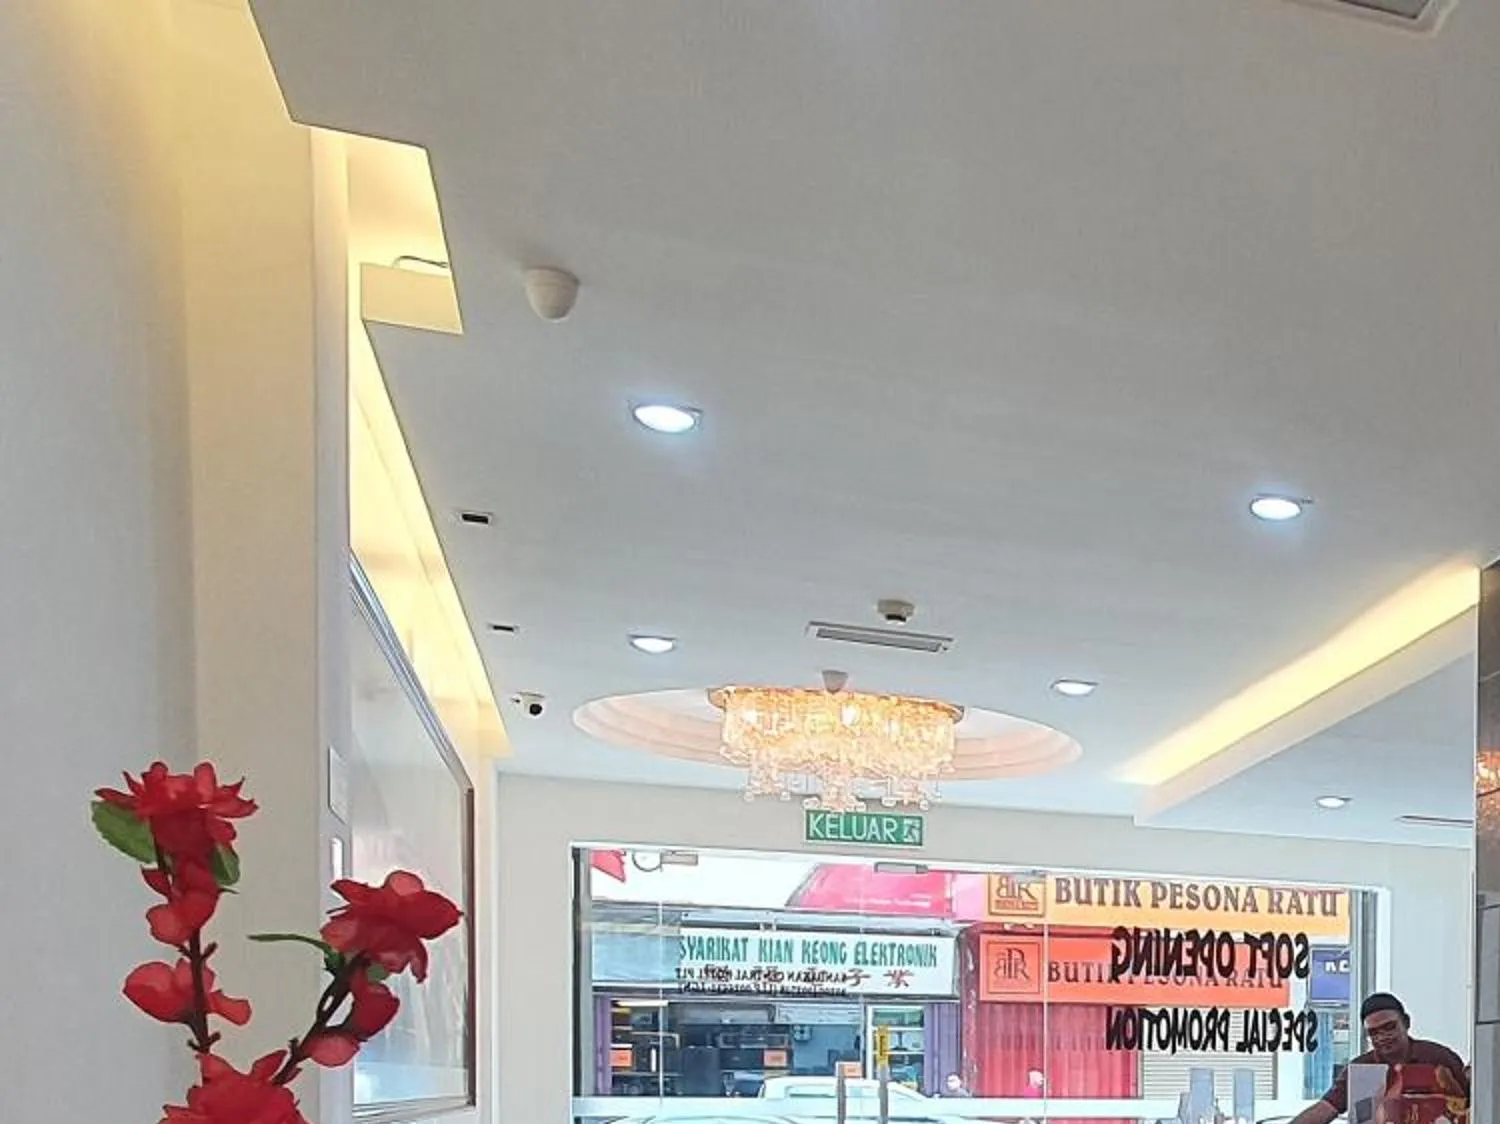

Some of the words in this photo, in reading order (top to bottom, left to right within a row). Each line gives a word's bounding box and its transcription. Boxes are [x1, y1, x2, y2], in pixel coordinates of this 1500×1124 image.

[809, 813, 897, 842] KELUAR
[1055, 876, 1142, 908] BUTIK
[1150, 880, 1259, 914] PESONA
[1267, 888, 1339, 918] RATU
[679, 936, 748, 963] SYARIKAT
[758, 940, 794, 966] KIAN
[801, 941, 847, 966] KEONG
[854, 942, 937, 967] ELEKTRONIK
